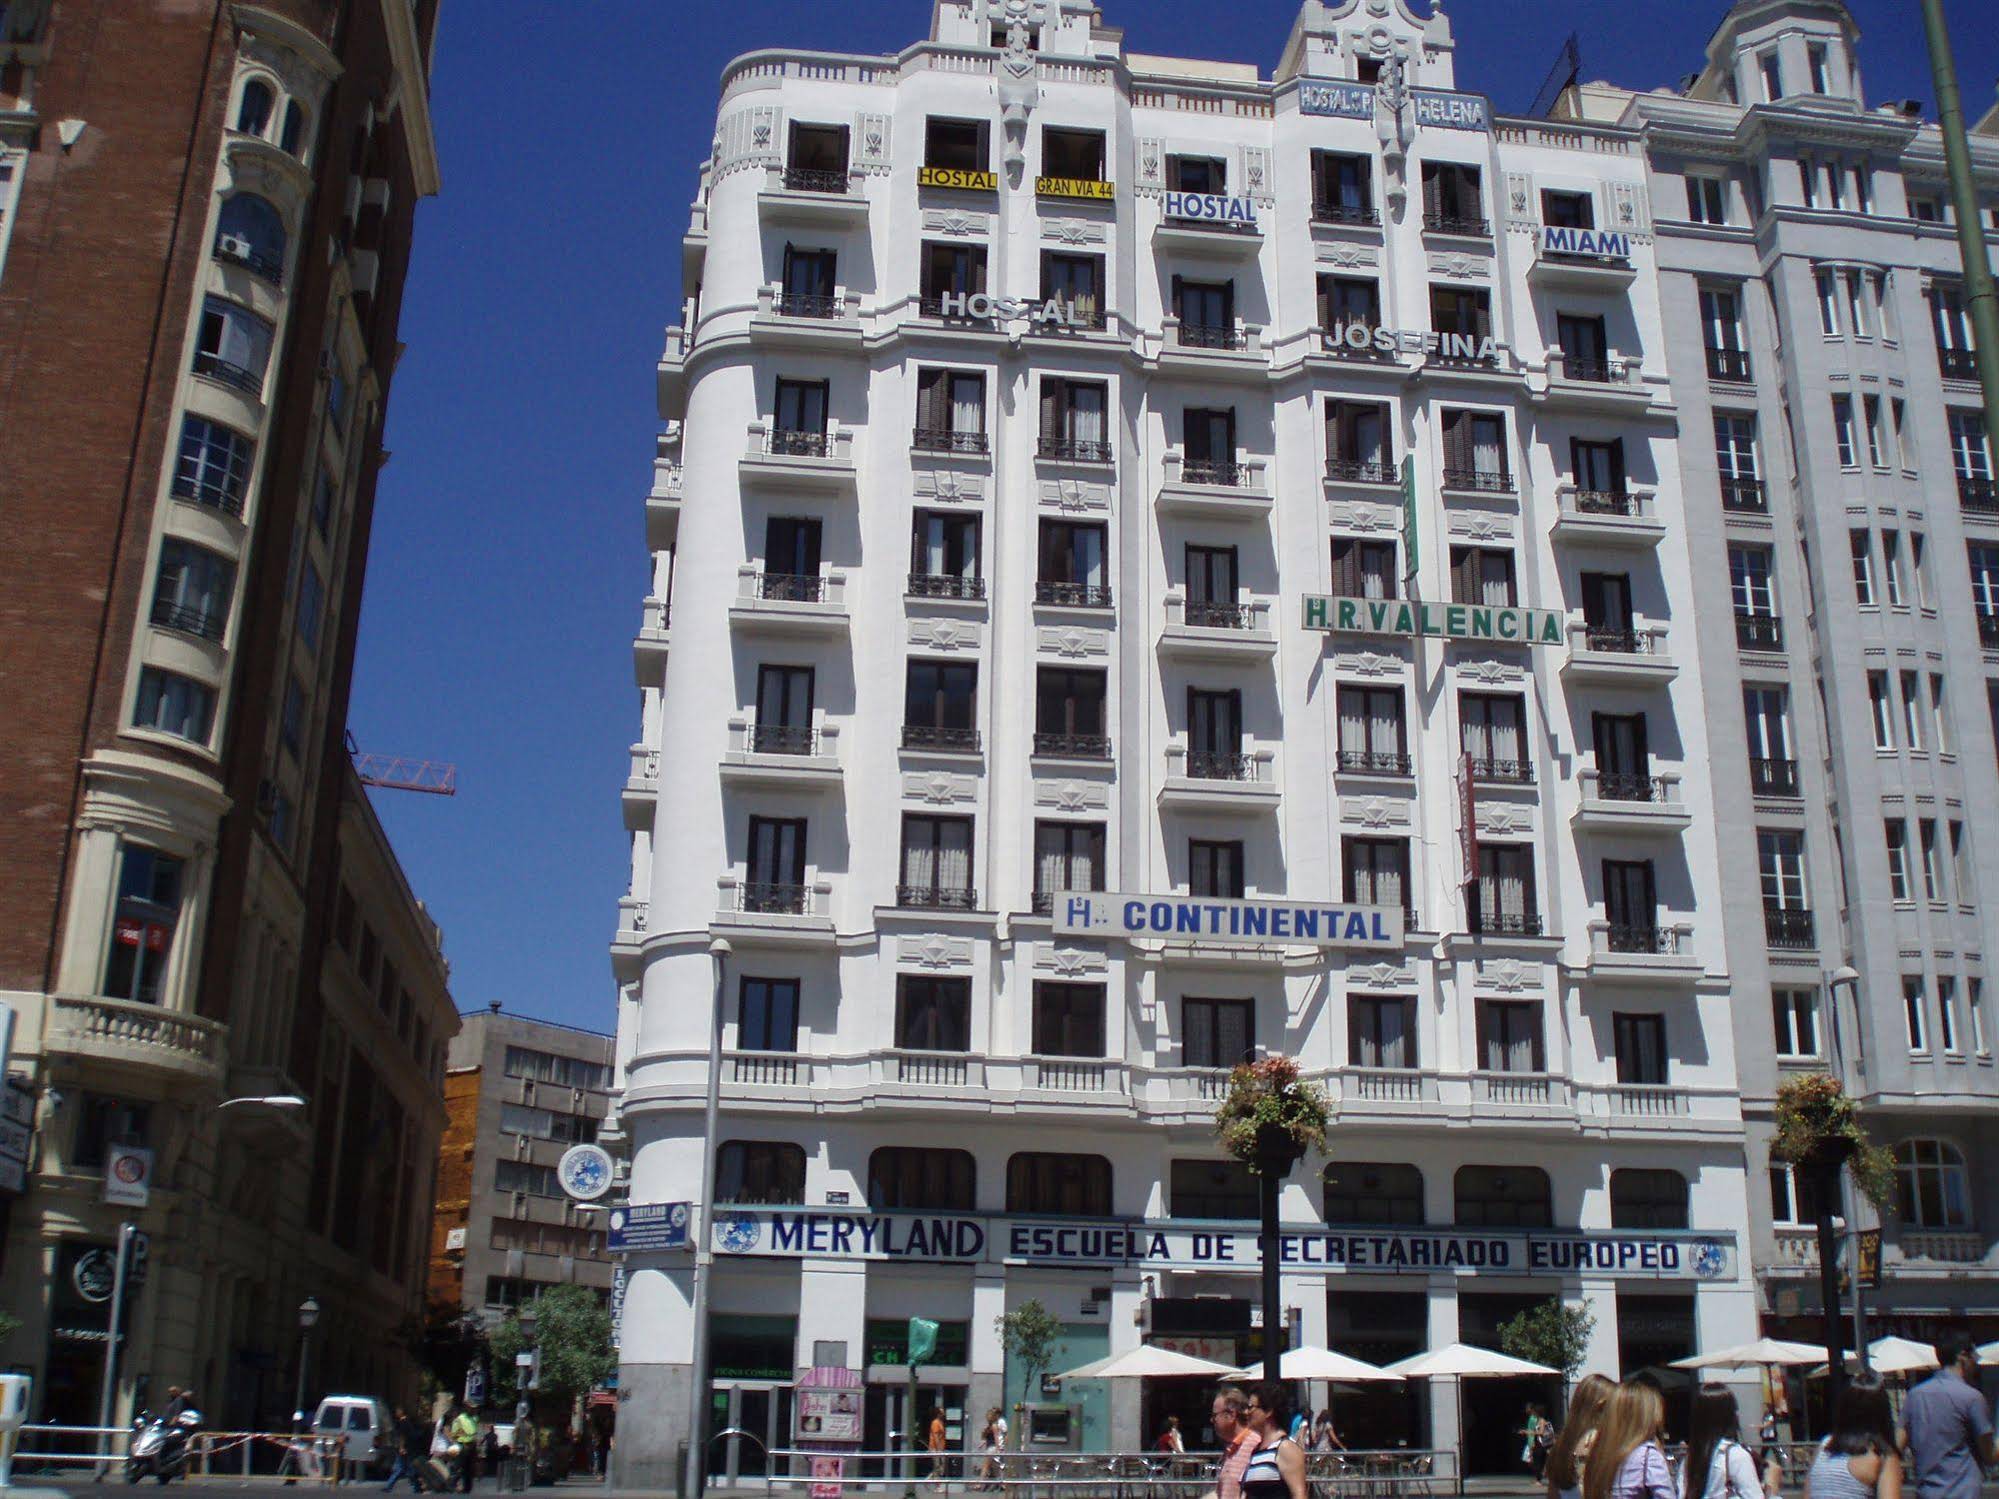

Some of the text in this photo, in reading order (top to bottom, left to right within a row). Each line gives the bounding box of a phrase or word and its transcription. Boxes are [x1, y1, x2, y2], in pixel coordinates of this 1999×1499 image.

[1301, 86, 1350, 111] HOSTAL
[1417, 98, 1484, 125] HELENA
[919, 169, 996, 188] HOSTAL
[1037, 178, 1113, 198] GRAN VIA 44
[1166, 192, 1256, 222] HOSTAL
[1545, 227, 1630, 255] MIAMI
[1325, 323, 1501, 359] JOSEFINA
[1123, 901, 1391, 941] CONTINENTAL
[771, 1213, 985, 1257] MERYLAND
[1010, 1228, 1170, 1259] ESCUELA
[1193, 1234, 1234, 1260] DE
[1530, 1241, 1680, 1269] EUROPEO
